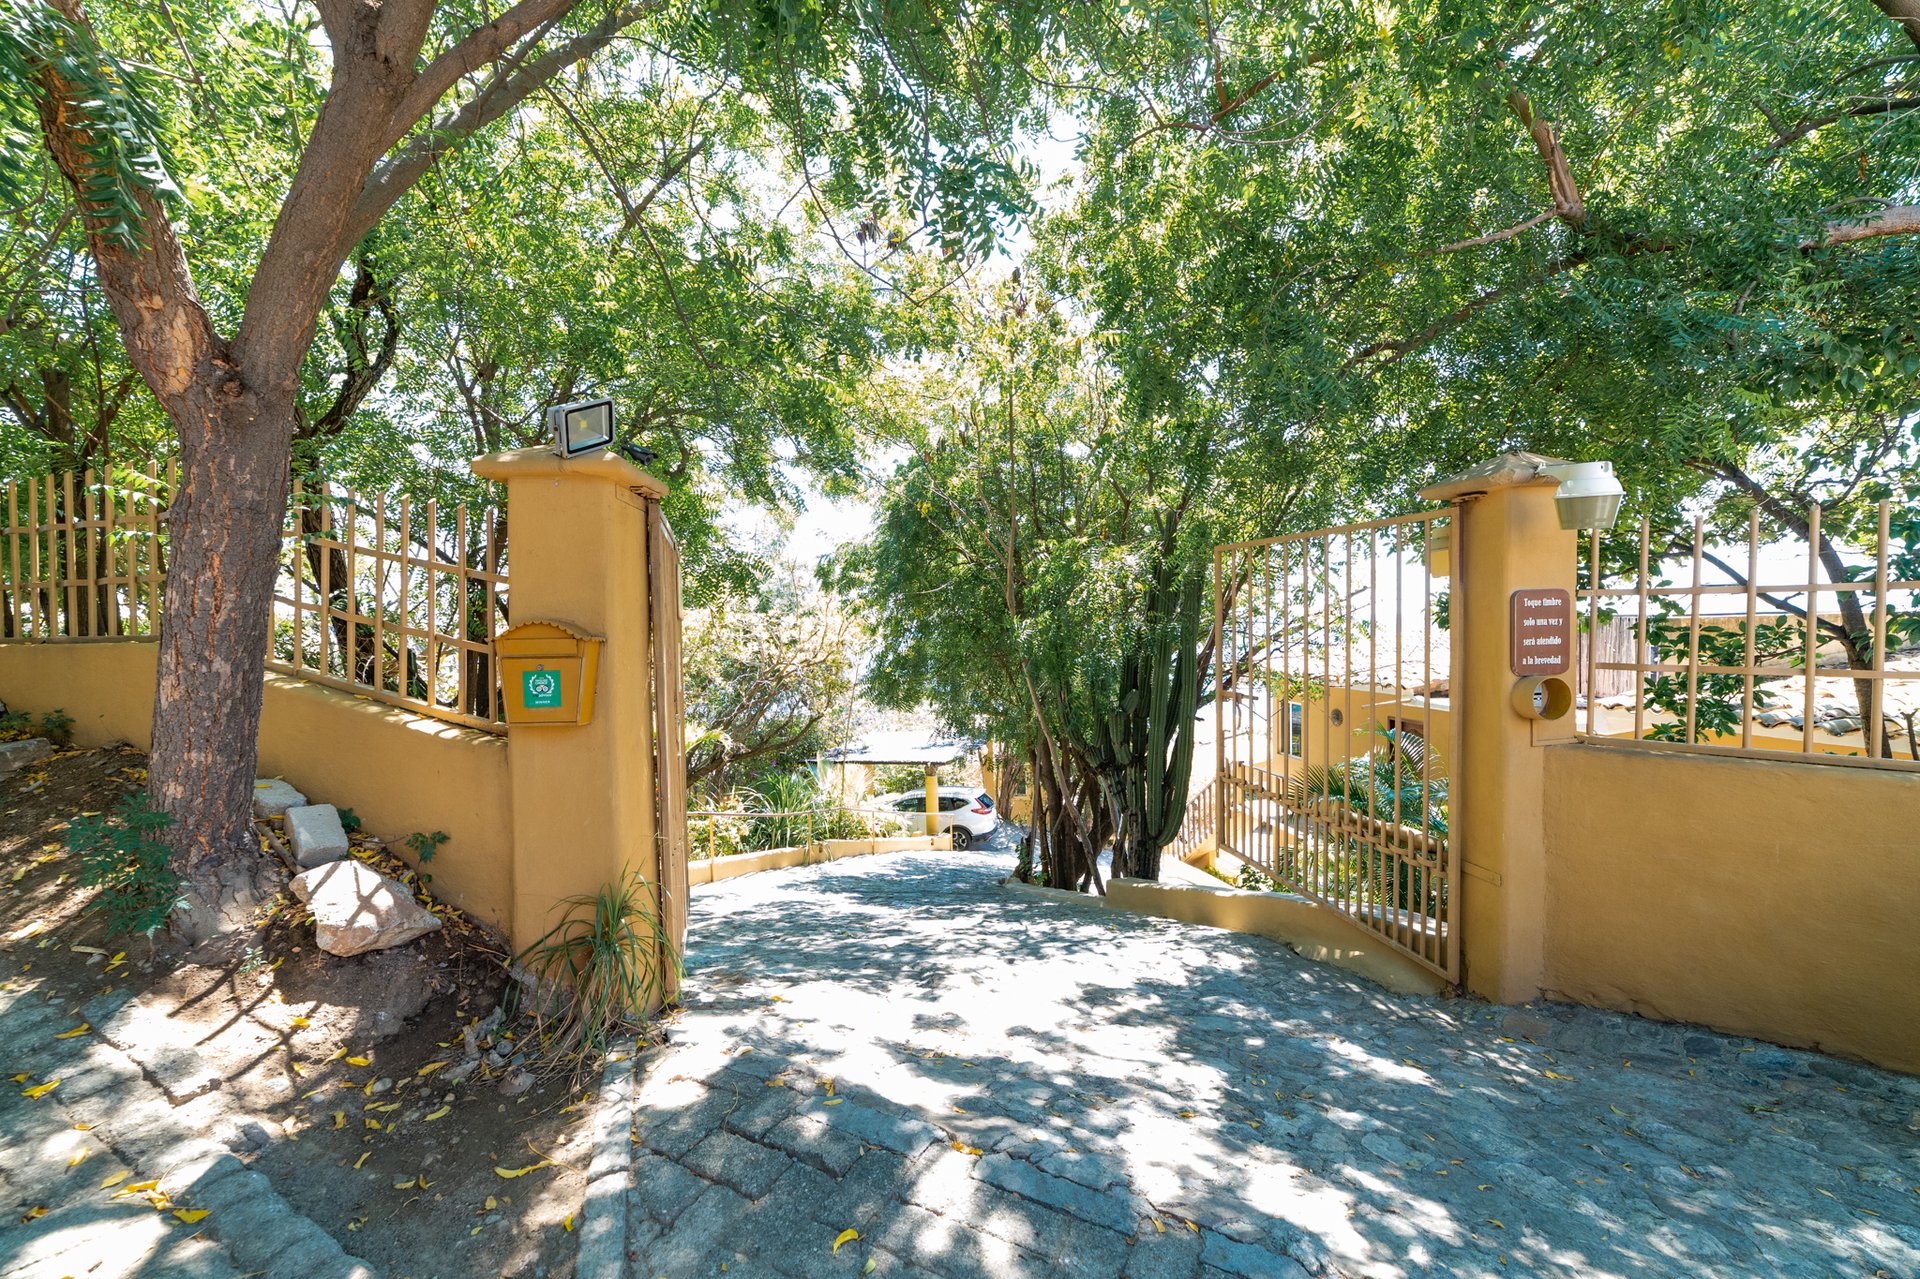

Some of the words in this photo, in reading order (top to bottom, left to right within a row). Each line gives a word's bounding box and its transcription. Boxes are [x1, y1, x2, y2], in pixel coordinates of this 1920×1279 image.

[1524, 598, 1542, 608] Toque
[1543, 597, 1562, 606] timbre
[1523, 617, 1535, 626] solo
[1548, 618, 1557, 626] vez
[1536, 636, 1561, 645] atendido
[1527, 656, 1533, 665] la
[1534, 655, 1561, 665] brevedad
